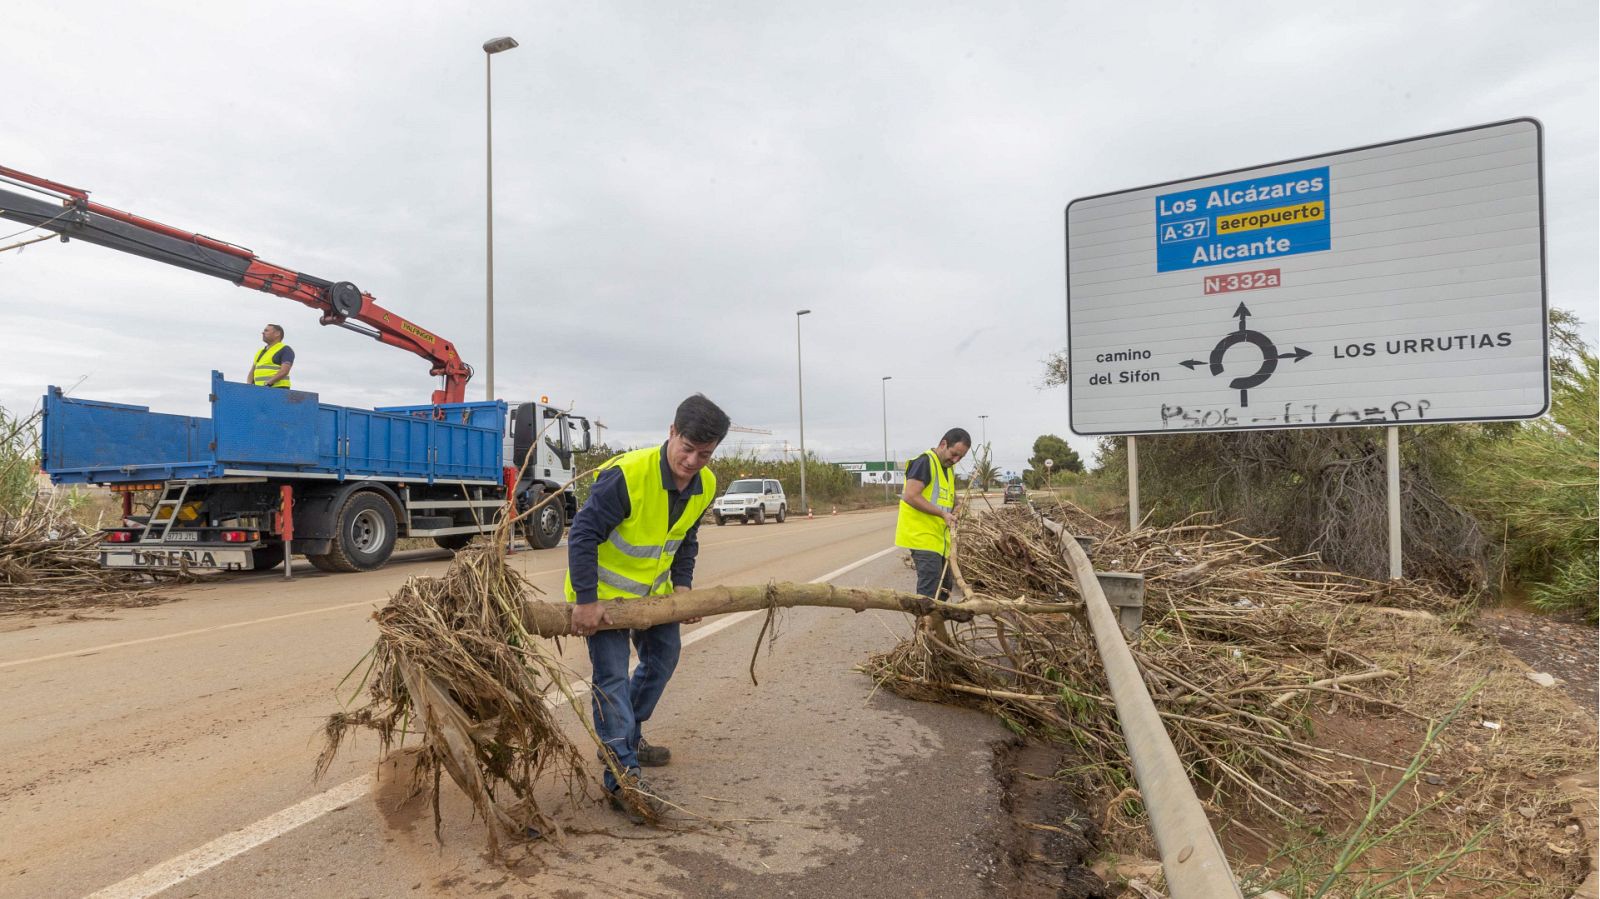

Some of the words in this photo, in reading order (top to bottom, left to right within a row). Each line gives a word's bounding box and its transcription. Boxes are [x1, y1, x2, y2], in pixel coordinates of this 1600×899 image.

[1159, 198, 1197, 216] Los
[1206, 177, 1324, 209] Alcázares
[1164, 221, 1206, 241] A-37
[1220, 205, 1321, 230] aeropuerto
[1191, 236, 1291, 264] Alicante
[1205, 272, 1278, 293] N-332a
[1096, 348, 1152, 363] camino
[1333, 342, 1376, 359] LOS
[1386, 332, 1512, 355] URRUTIAS
[1089, 372, 1113, 386] del
[1119, 369, 1160, 383] Sifón
